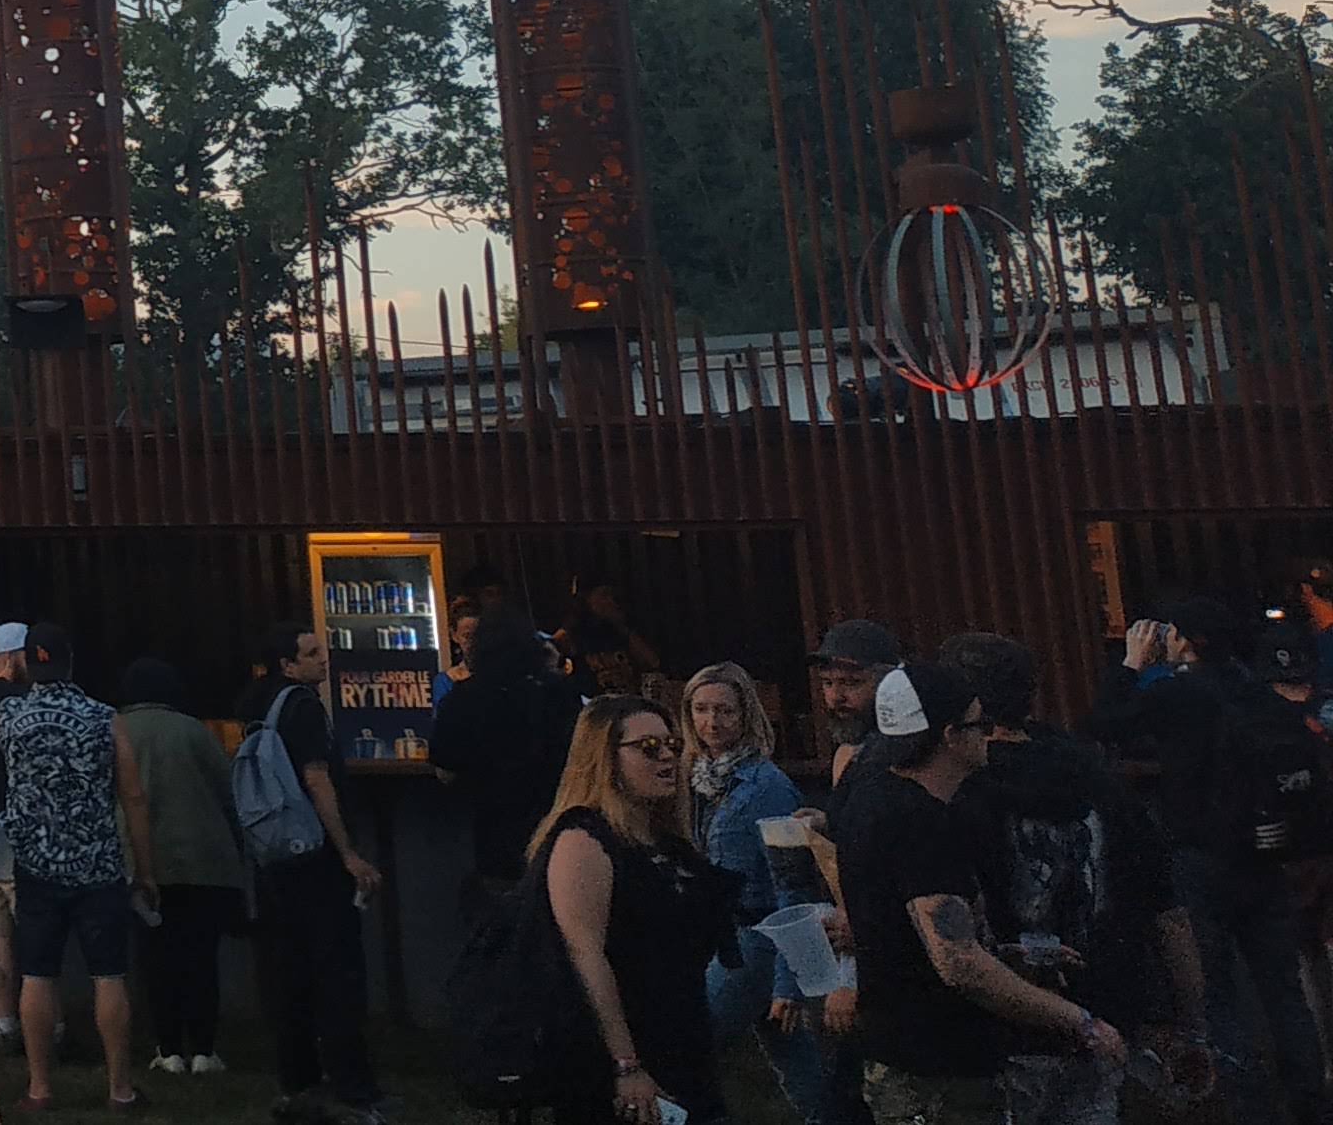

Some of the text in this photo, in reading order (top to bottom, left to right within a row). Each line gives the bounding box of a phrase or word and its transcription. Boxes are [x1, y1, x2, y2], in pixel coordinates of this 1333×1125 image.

[372, 670, 414, 684] GARDER
[417, 670, 430, 684] LE
[340, 683, 434, 708] RYTHME
